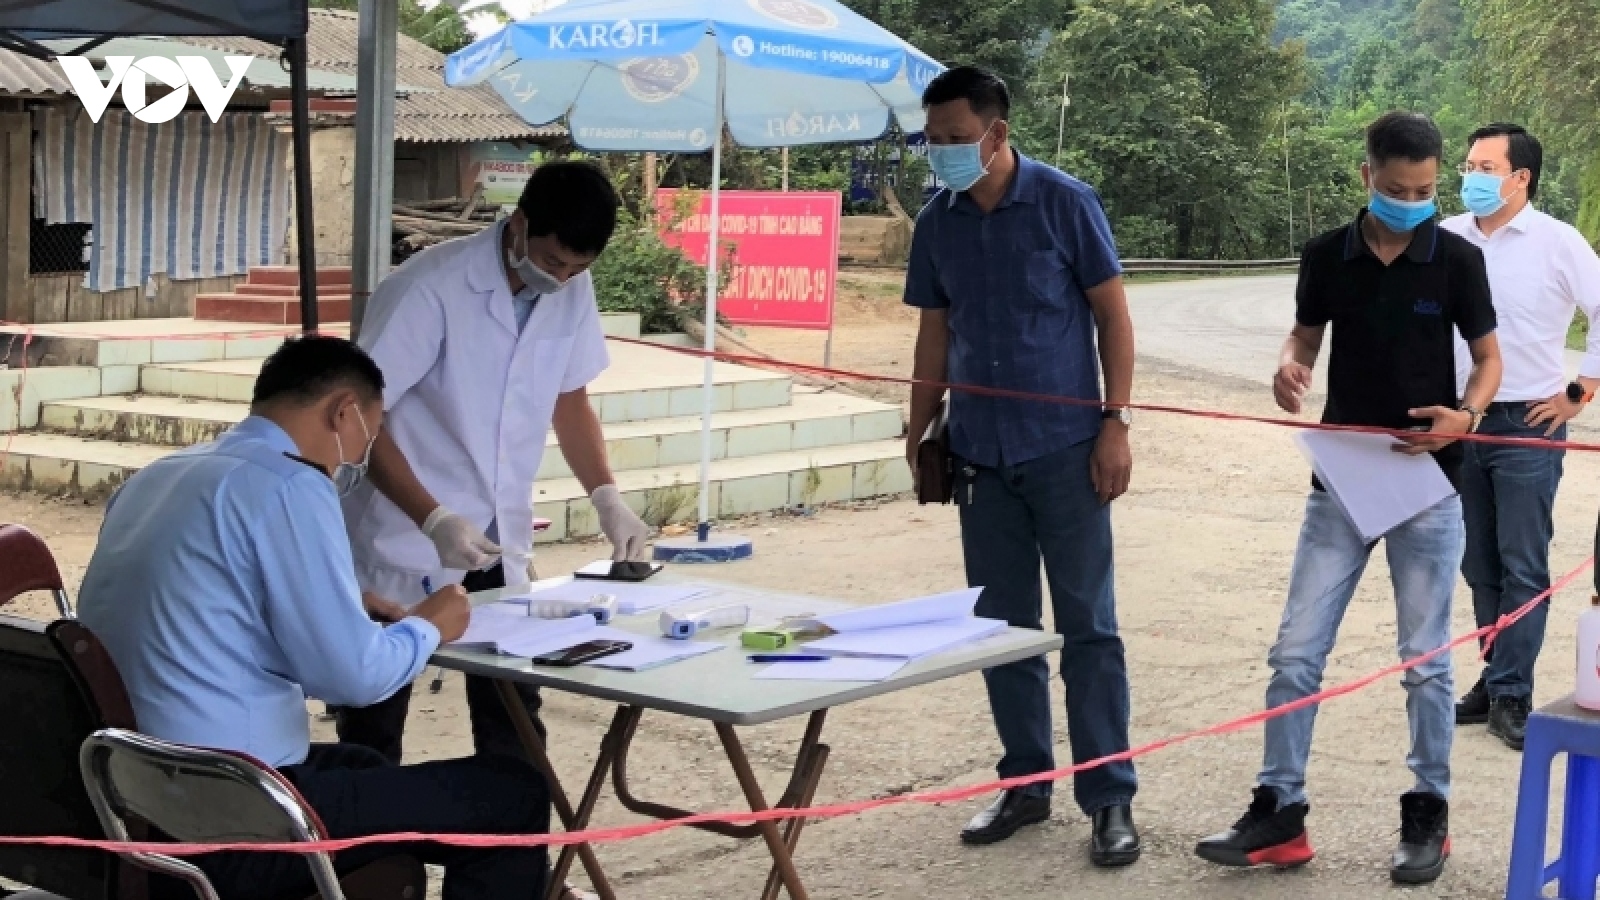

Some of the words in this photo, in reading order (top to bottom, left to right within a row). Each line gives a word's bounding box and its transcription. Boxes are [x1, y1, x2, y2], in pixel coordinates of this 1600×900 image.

[549, 18, 658, 48] KAROFI
[760, 42, 817, 60] Hotline:
[822, 50, 889, 69] 19006418
[779, 215, 797, 236] CAO
[748, 266, 774, 310] DỊCH
[776, 266, 826, 302] COVID-19
